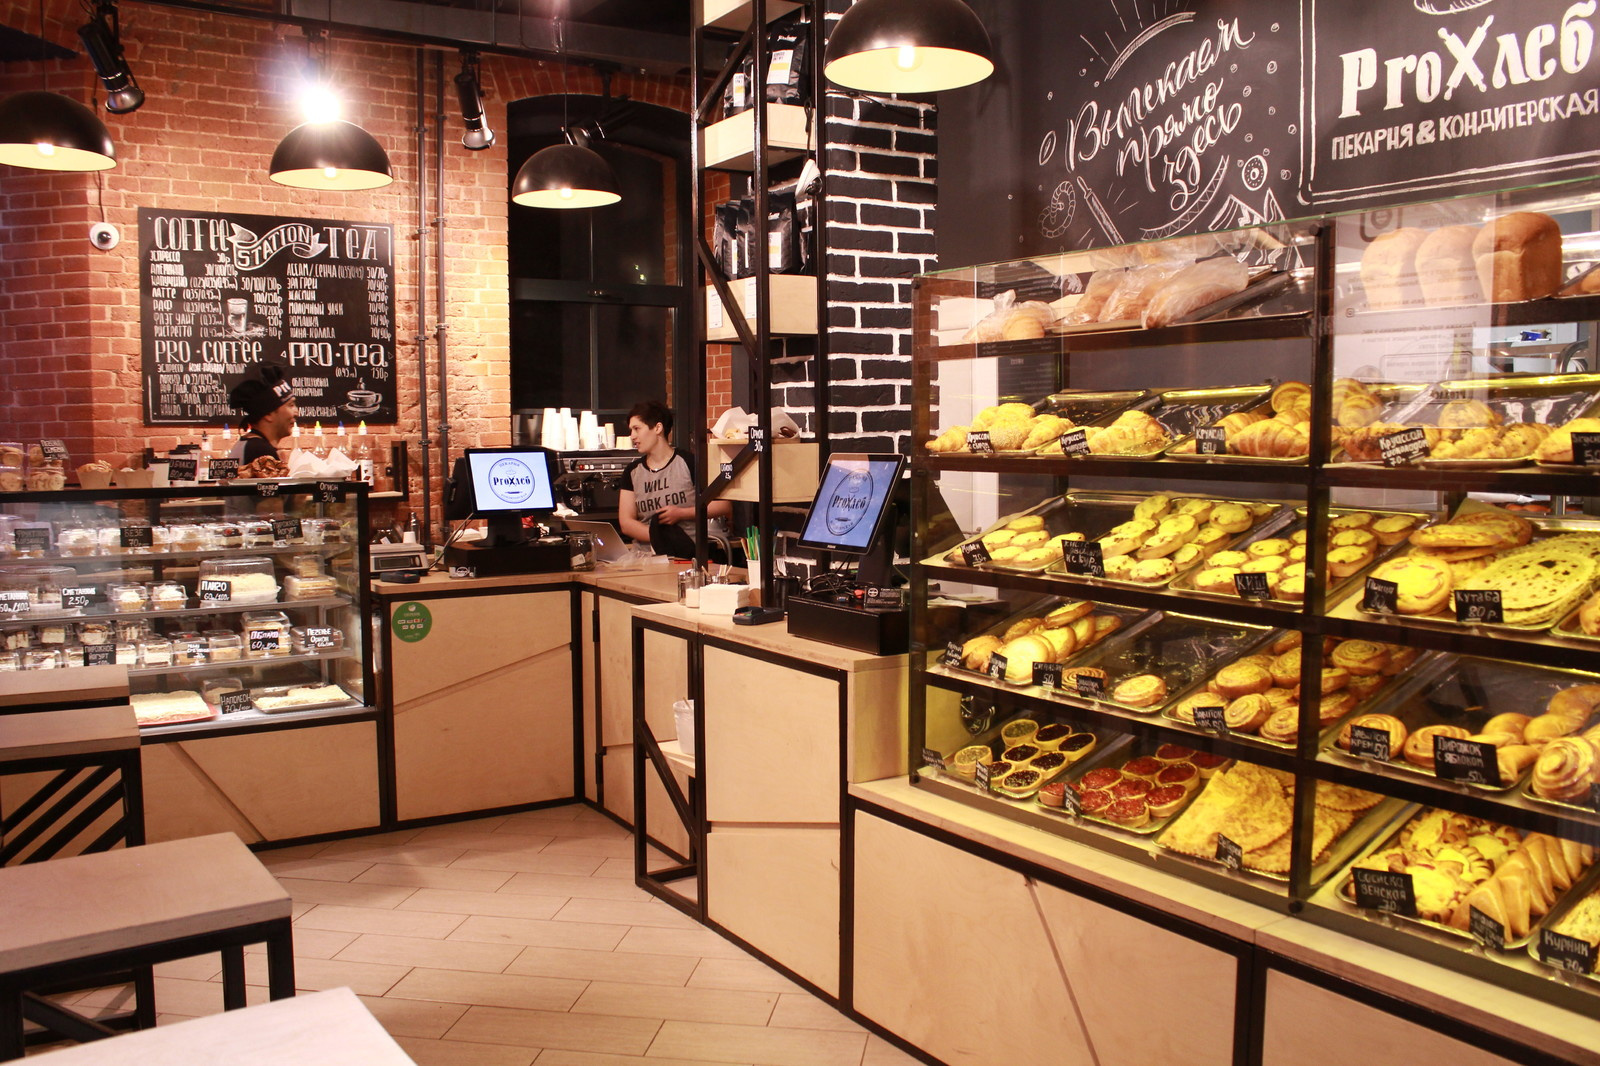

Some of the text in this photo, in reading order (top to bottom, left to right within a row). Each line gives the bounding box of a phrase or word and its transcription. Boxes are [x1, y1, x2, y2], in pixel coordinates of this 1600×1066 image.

[1065, 17, 1256, 173] Выпекаем
[1116, 77, 1224, 193] прямо
[1331, 87, 1599, 161] ПЕКАРНЯ & КОНДИТЕРСКАЯ
[1163, 102, 1242, 212] здесь
[237, 225, 311, 267] STATION
[153, 300, 173, 312] РАФ
[289, 301, 325, 315] МОЛОЧНЫЙ
[155, 340, 191, 363] PRO
[288, 342, 333, 367] PRO
[1379, 429, 1425, 451] Круассан
[210, 460, 239, 470] КРЕНДЕЛЬ
[644, 477, 669, 494] WILL
[665, 491, 687, 506] FOR
[124, 528, 144, 538] БЕЗЕ
[1236, 575, 1267, 591] КИШ
[220, 693, 251, 707] НАПОЛЕОН
[1544, 930, 1589, 957] Курник
